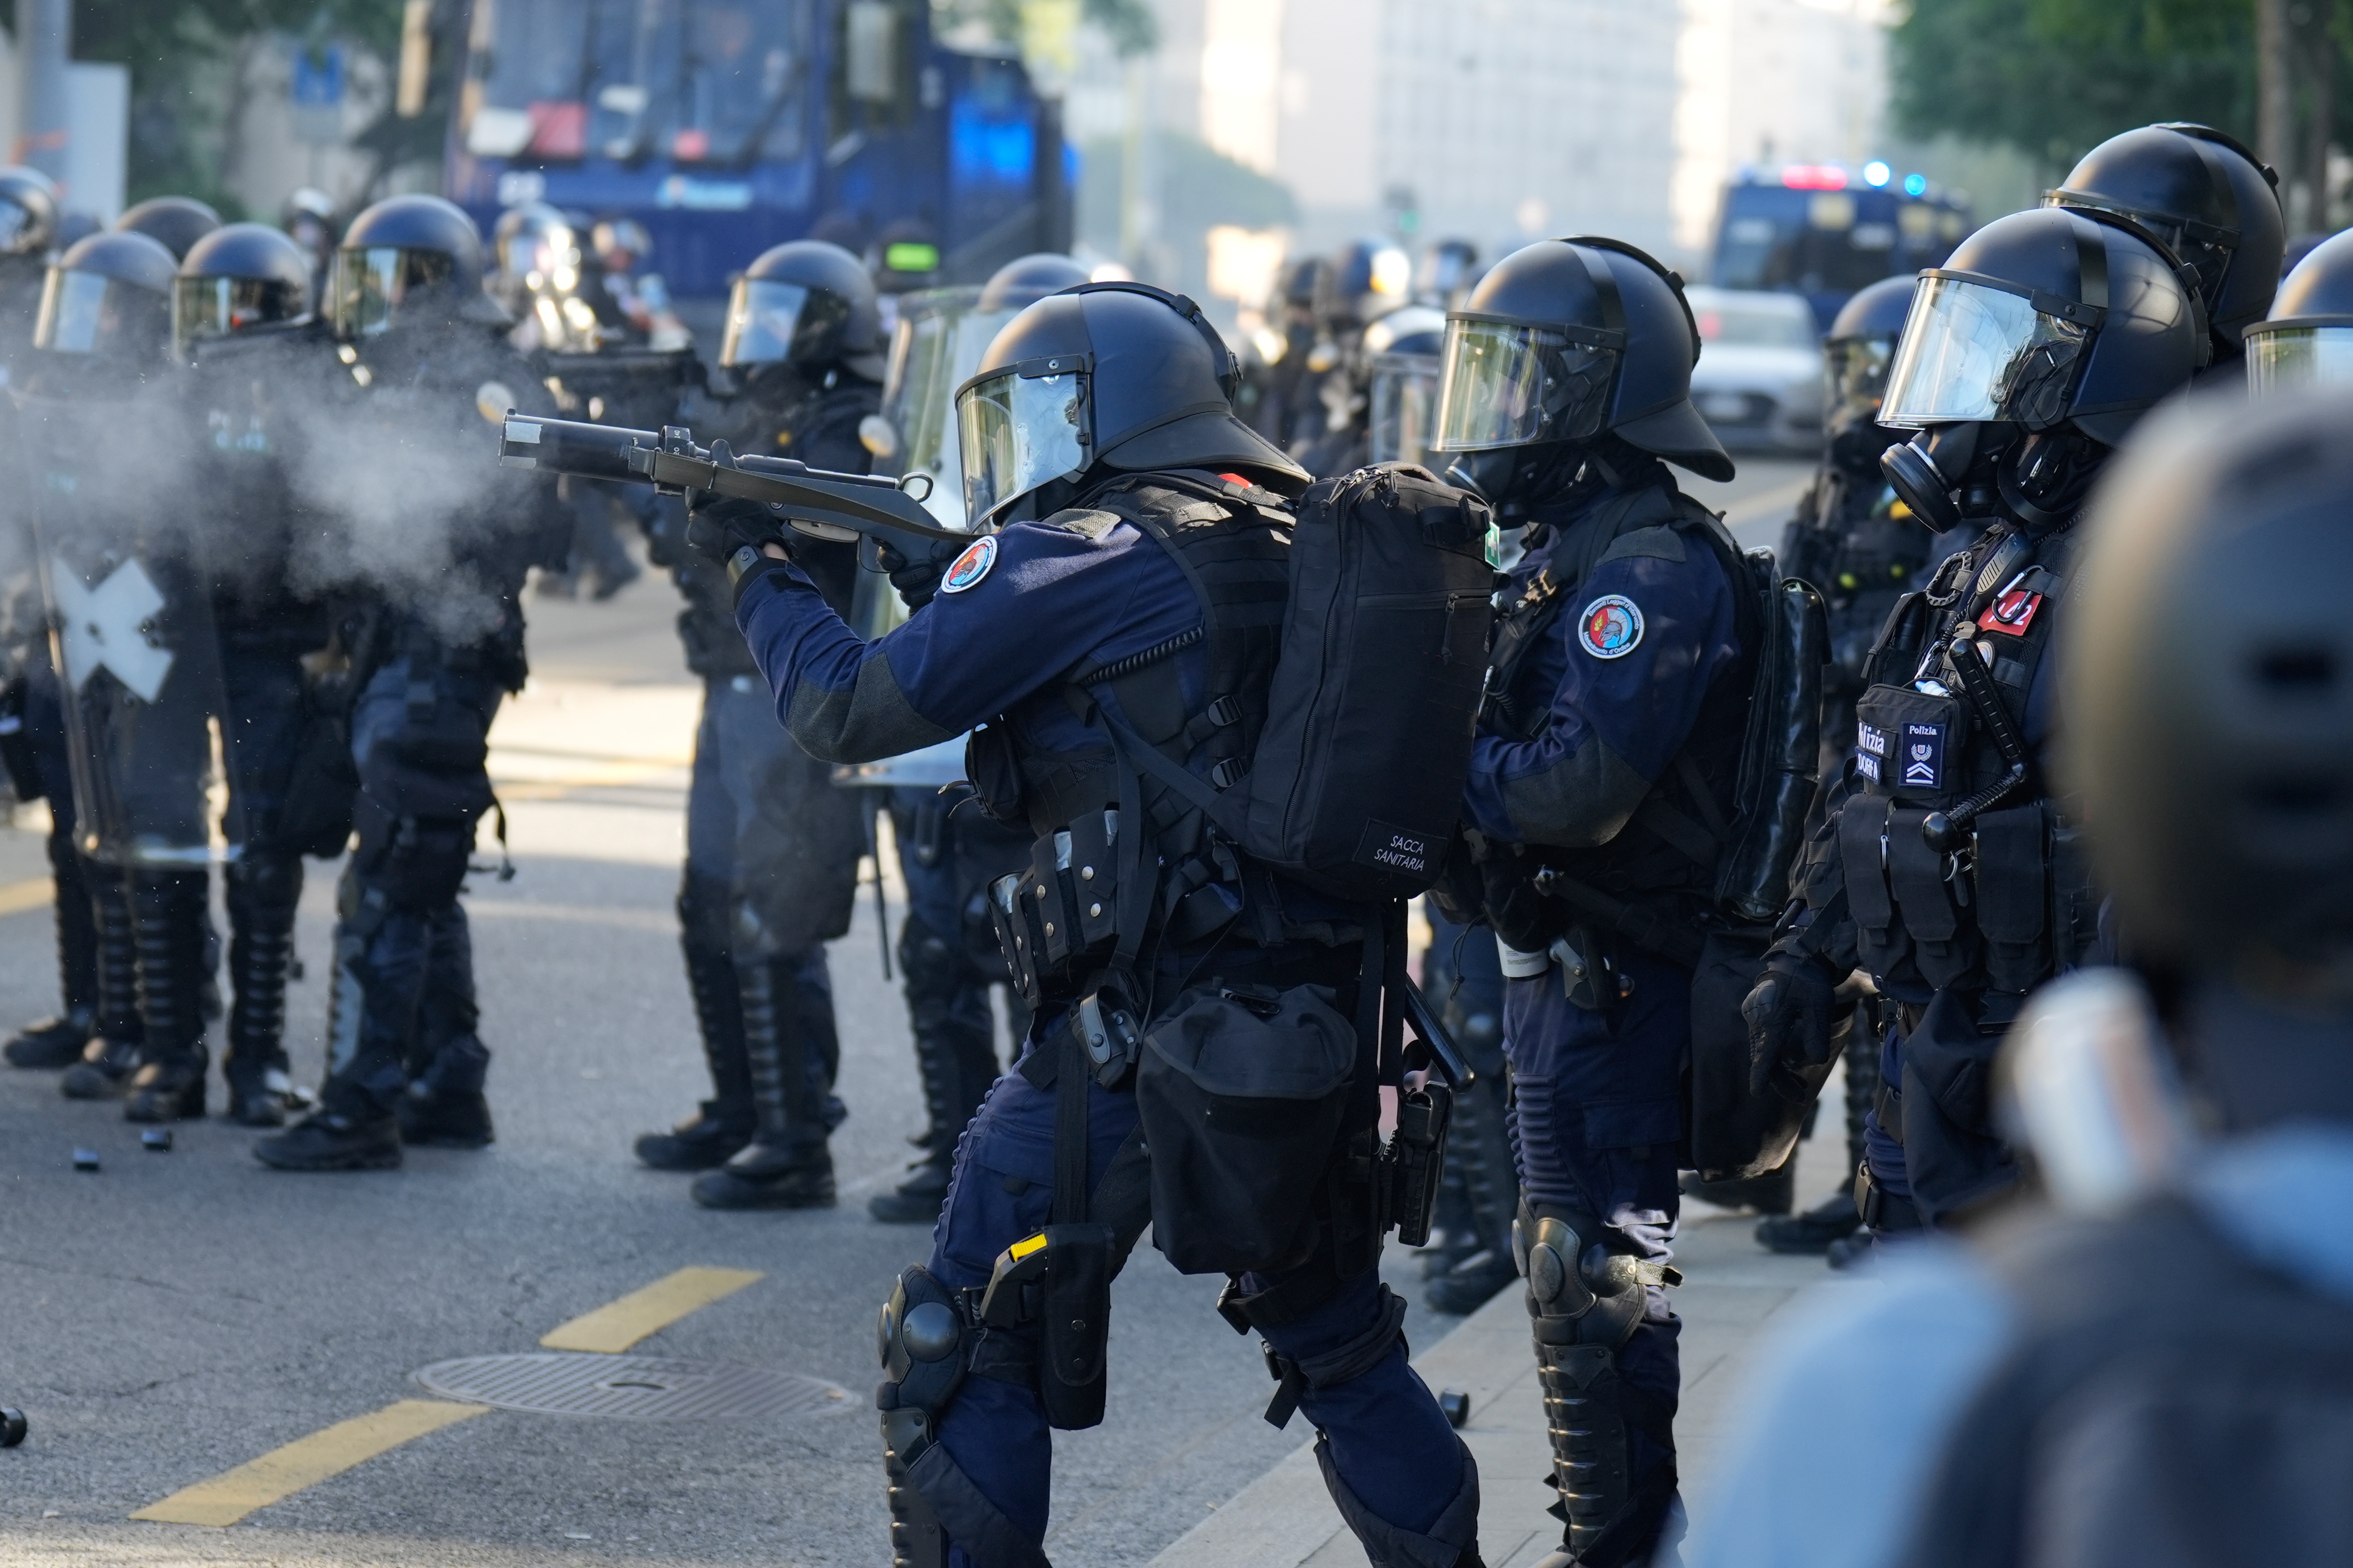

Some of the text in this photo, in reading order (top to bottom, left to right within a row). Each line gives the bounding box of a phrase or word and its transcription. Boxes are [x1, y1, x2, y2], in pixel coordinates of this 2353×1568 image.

[1910, 725, 1937, 735] Polizia
[1390, 835, 1424, 855] SACCA
[1374, 848, 1425, 872] SANITARIA
